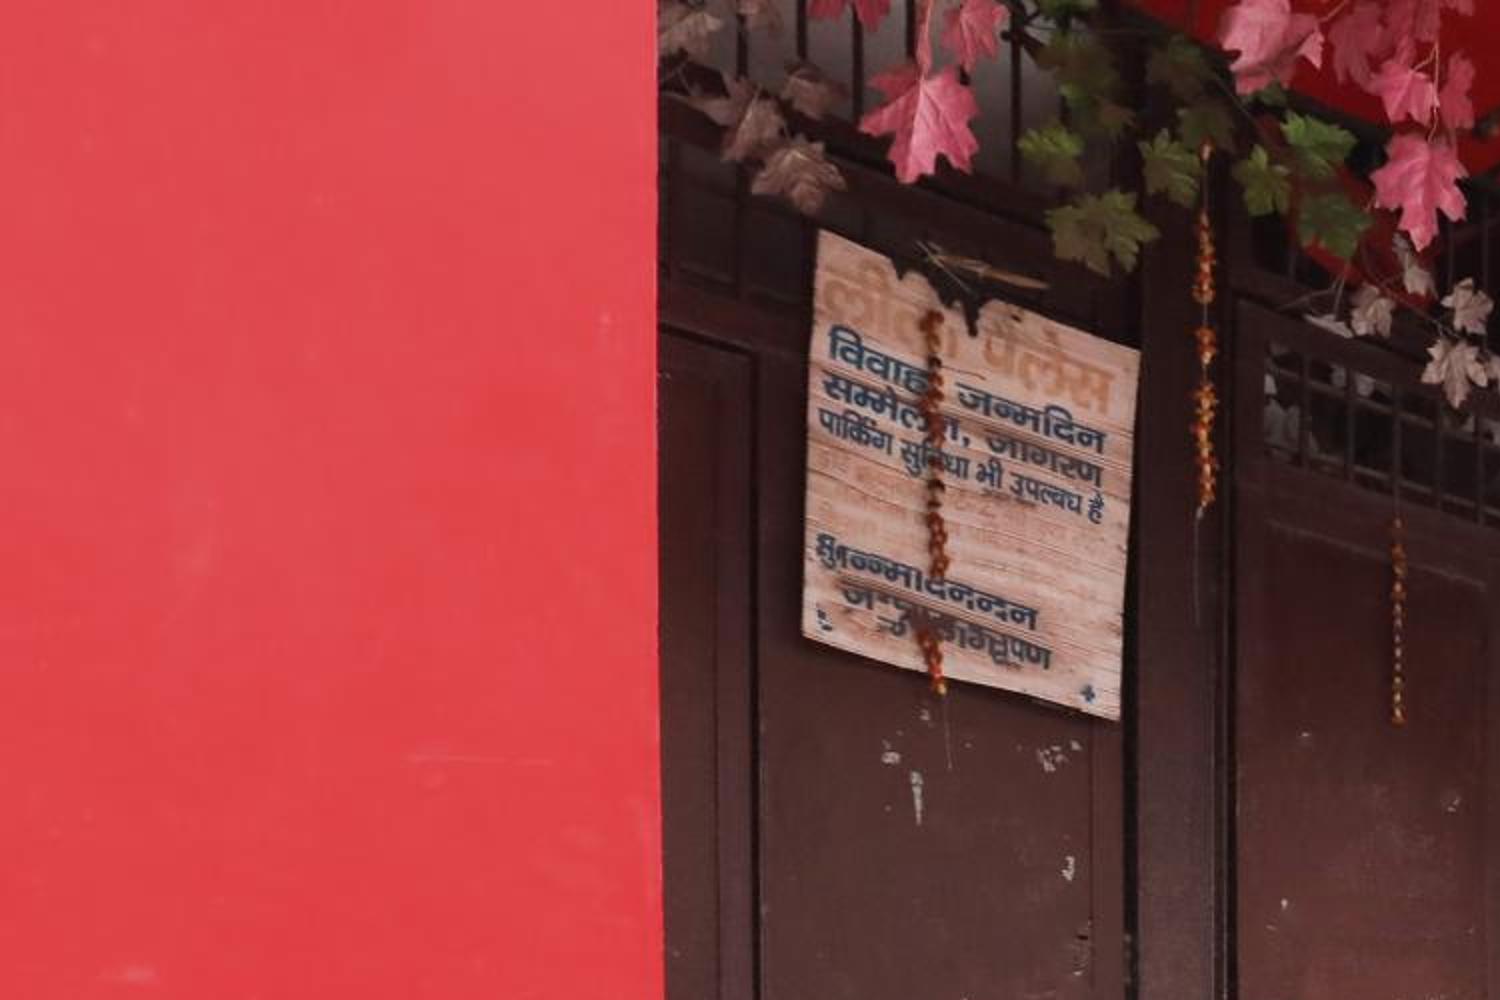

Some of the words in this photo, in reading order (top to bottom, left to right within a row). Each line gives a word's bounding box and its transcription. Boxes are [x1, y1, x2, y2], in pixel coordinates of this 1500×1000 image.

[954, 380, 1106, 455] जन्मदिन
[900, 437, 970, 479] सुिधा
[976, 460, 1004, 490] भी
[1087, 490, 1106, 525] है
[984, 427, 1104, 489] जागरण
